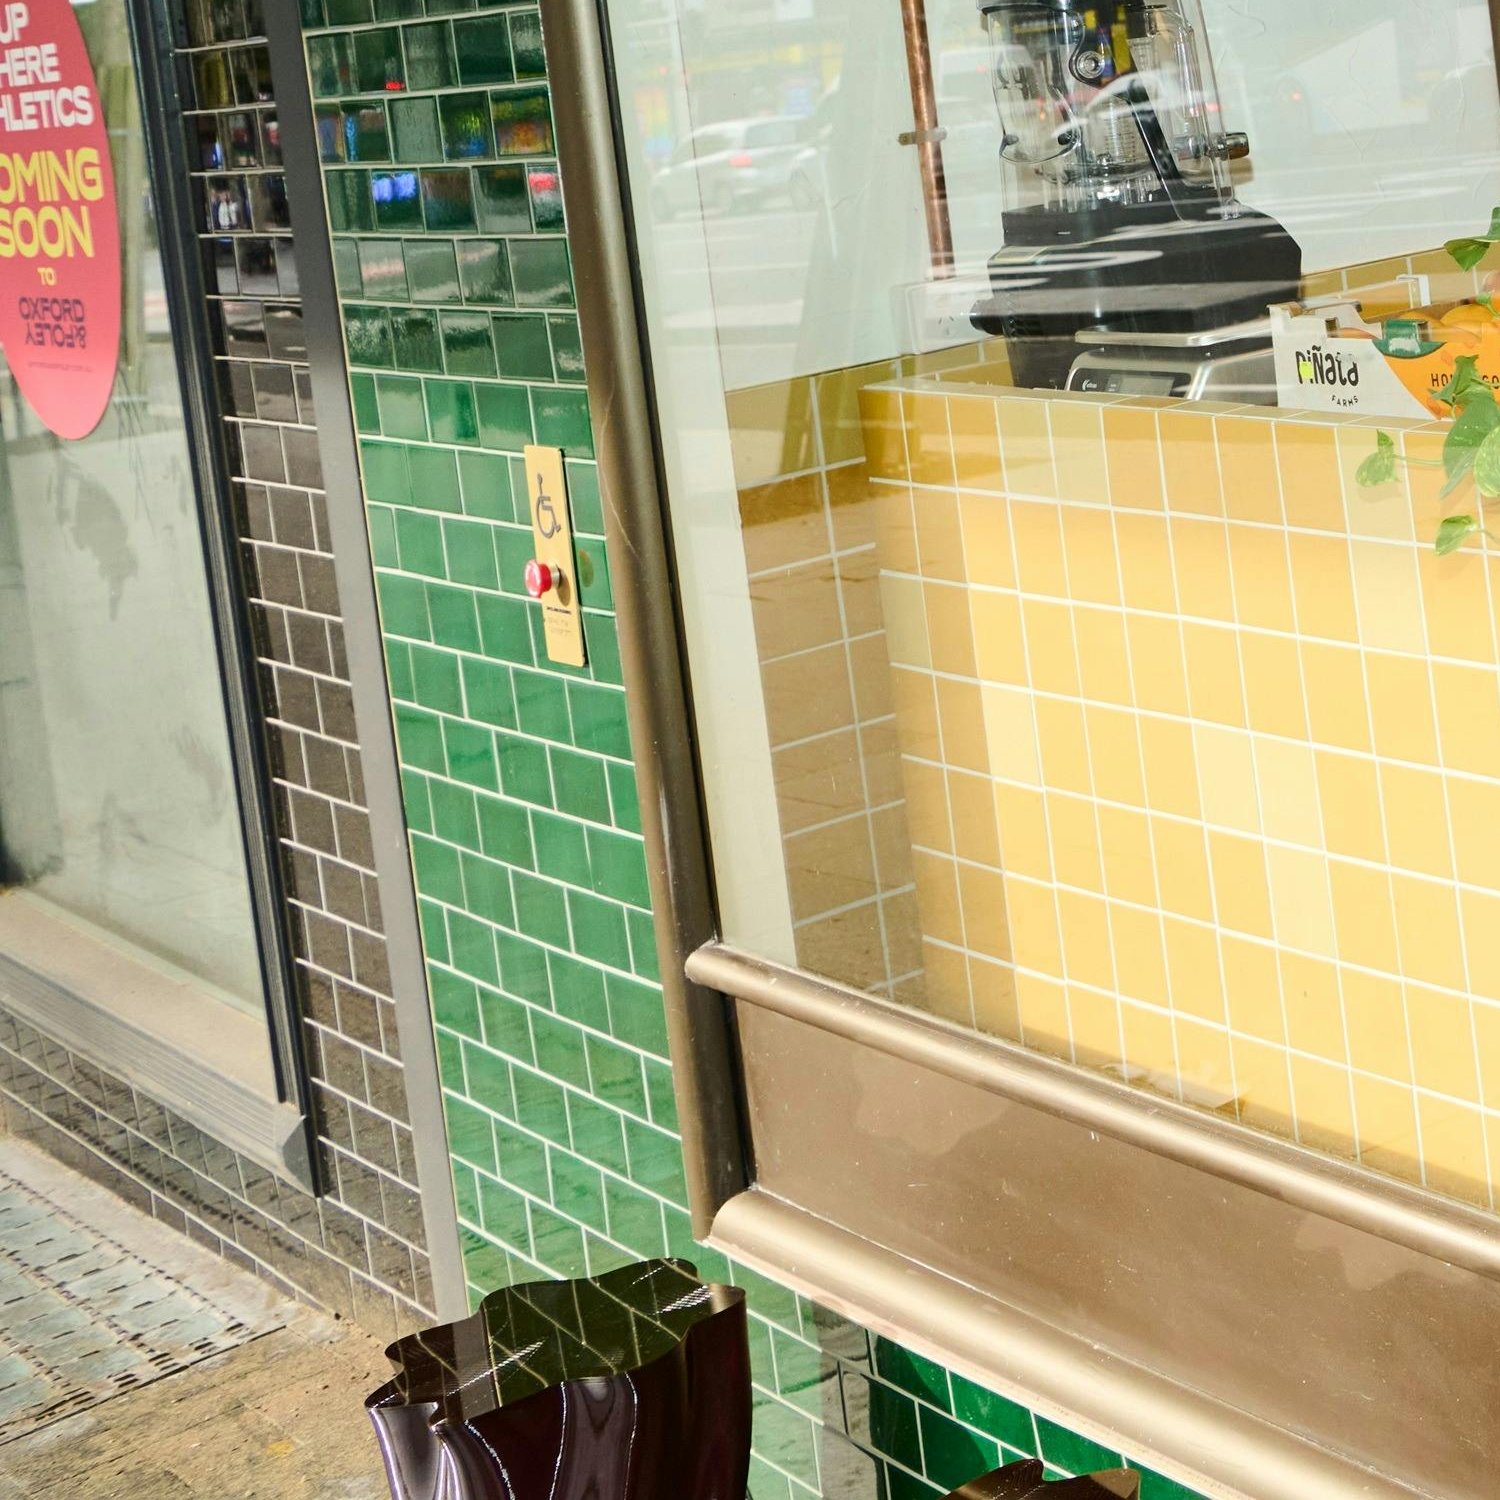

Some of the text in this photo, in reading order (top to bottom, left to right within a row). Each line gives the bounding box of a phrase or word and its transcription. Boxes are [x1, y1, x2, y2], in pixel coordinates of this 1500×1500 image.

[0, 204, 96, 259] SOON
[37, 266, 57, 287] TO
[18, 295, 86, 324] OXFORD
[1331, 394, 1359, 407] FARMS
